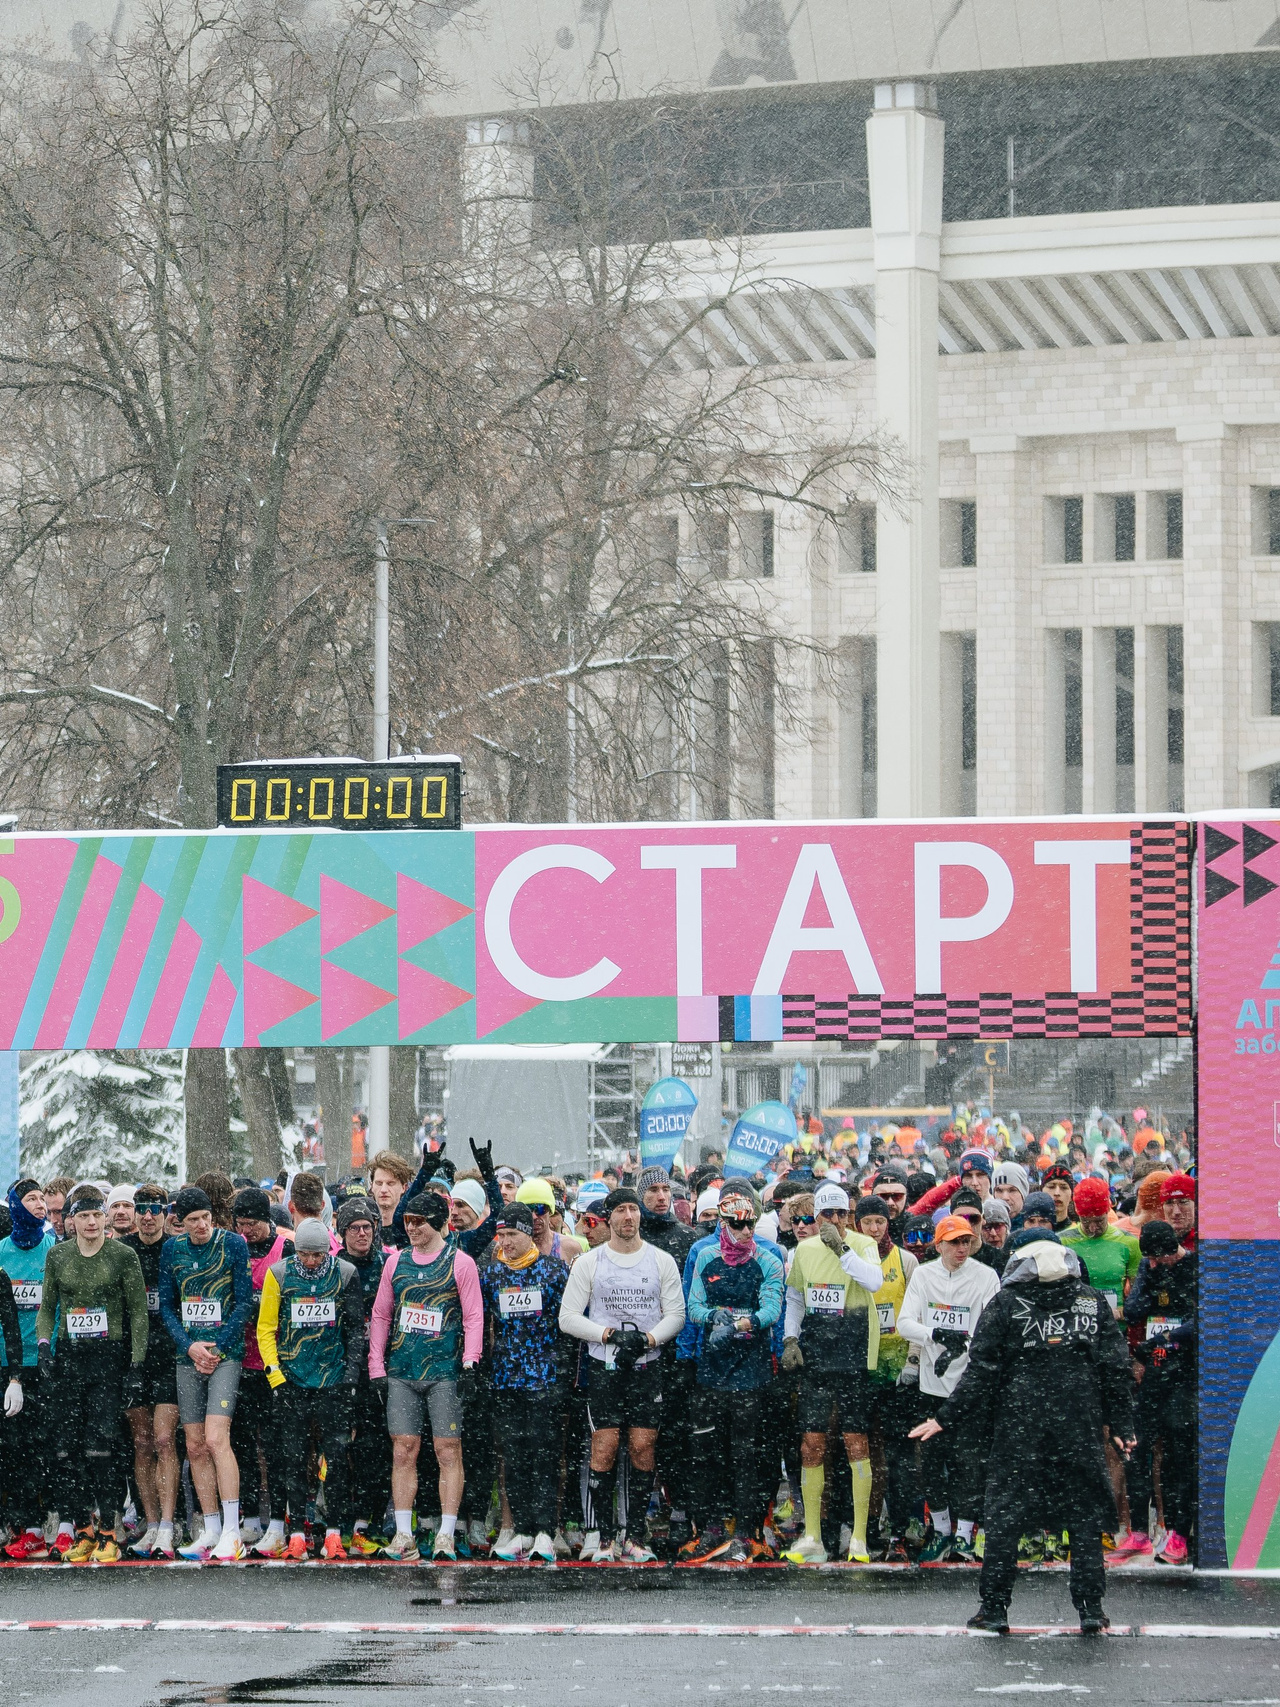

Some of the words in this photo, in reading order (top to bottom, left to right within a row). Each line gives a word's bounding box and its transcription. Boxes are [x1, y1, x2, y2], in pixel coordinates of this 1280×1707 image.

[230, 777, 447, 821] 00:00:00
[484, 839, 1131, 1002] СТАРТ
[648, 1114, 686, 1134] 20:00
[736, 1129, 779, 1156] 20:00
[508, 1293, 532, 1306] 246
[811, 1290, 840, 1303] 3663
[187, 1304, 215, 1315] 6729
[297, 1304, 330, 1316] 6726
[71, 1315, 101, 1327] 2239
[406, 1311, 436, 1327] 7351
[932, 1312, 963, 1325] 4781
